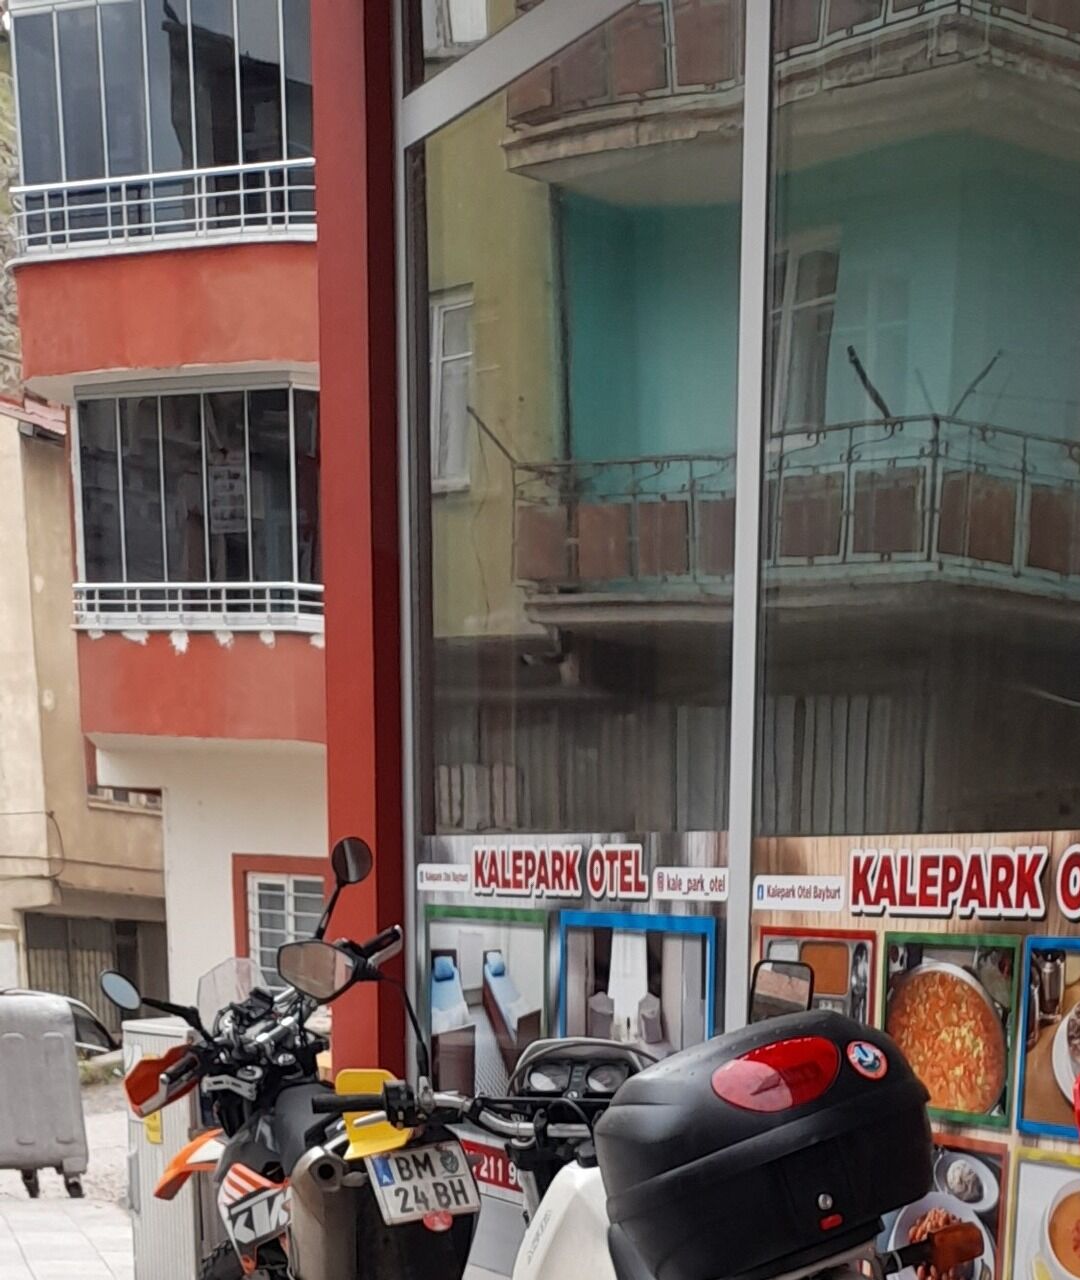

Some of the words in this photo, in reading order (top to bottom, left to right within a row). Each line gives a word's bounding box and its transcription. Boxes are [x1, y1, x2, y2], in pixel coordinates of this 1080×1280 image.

[473, 848, 580, 891] KALEPARK
[587, 848, 646, 893] OTEL
[667, 873, 725, 895] kale_park_otel
[851, 852, 1043, 910] KALEPARK
[393, 1152, 436, 1182] BM
[394, 1184, 429, 1214] 24
[432, 1178, 470, 1209] BH
